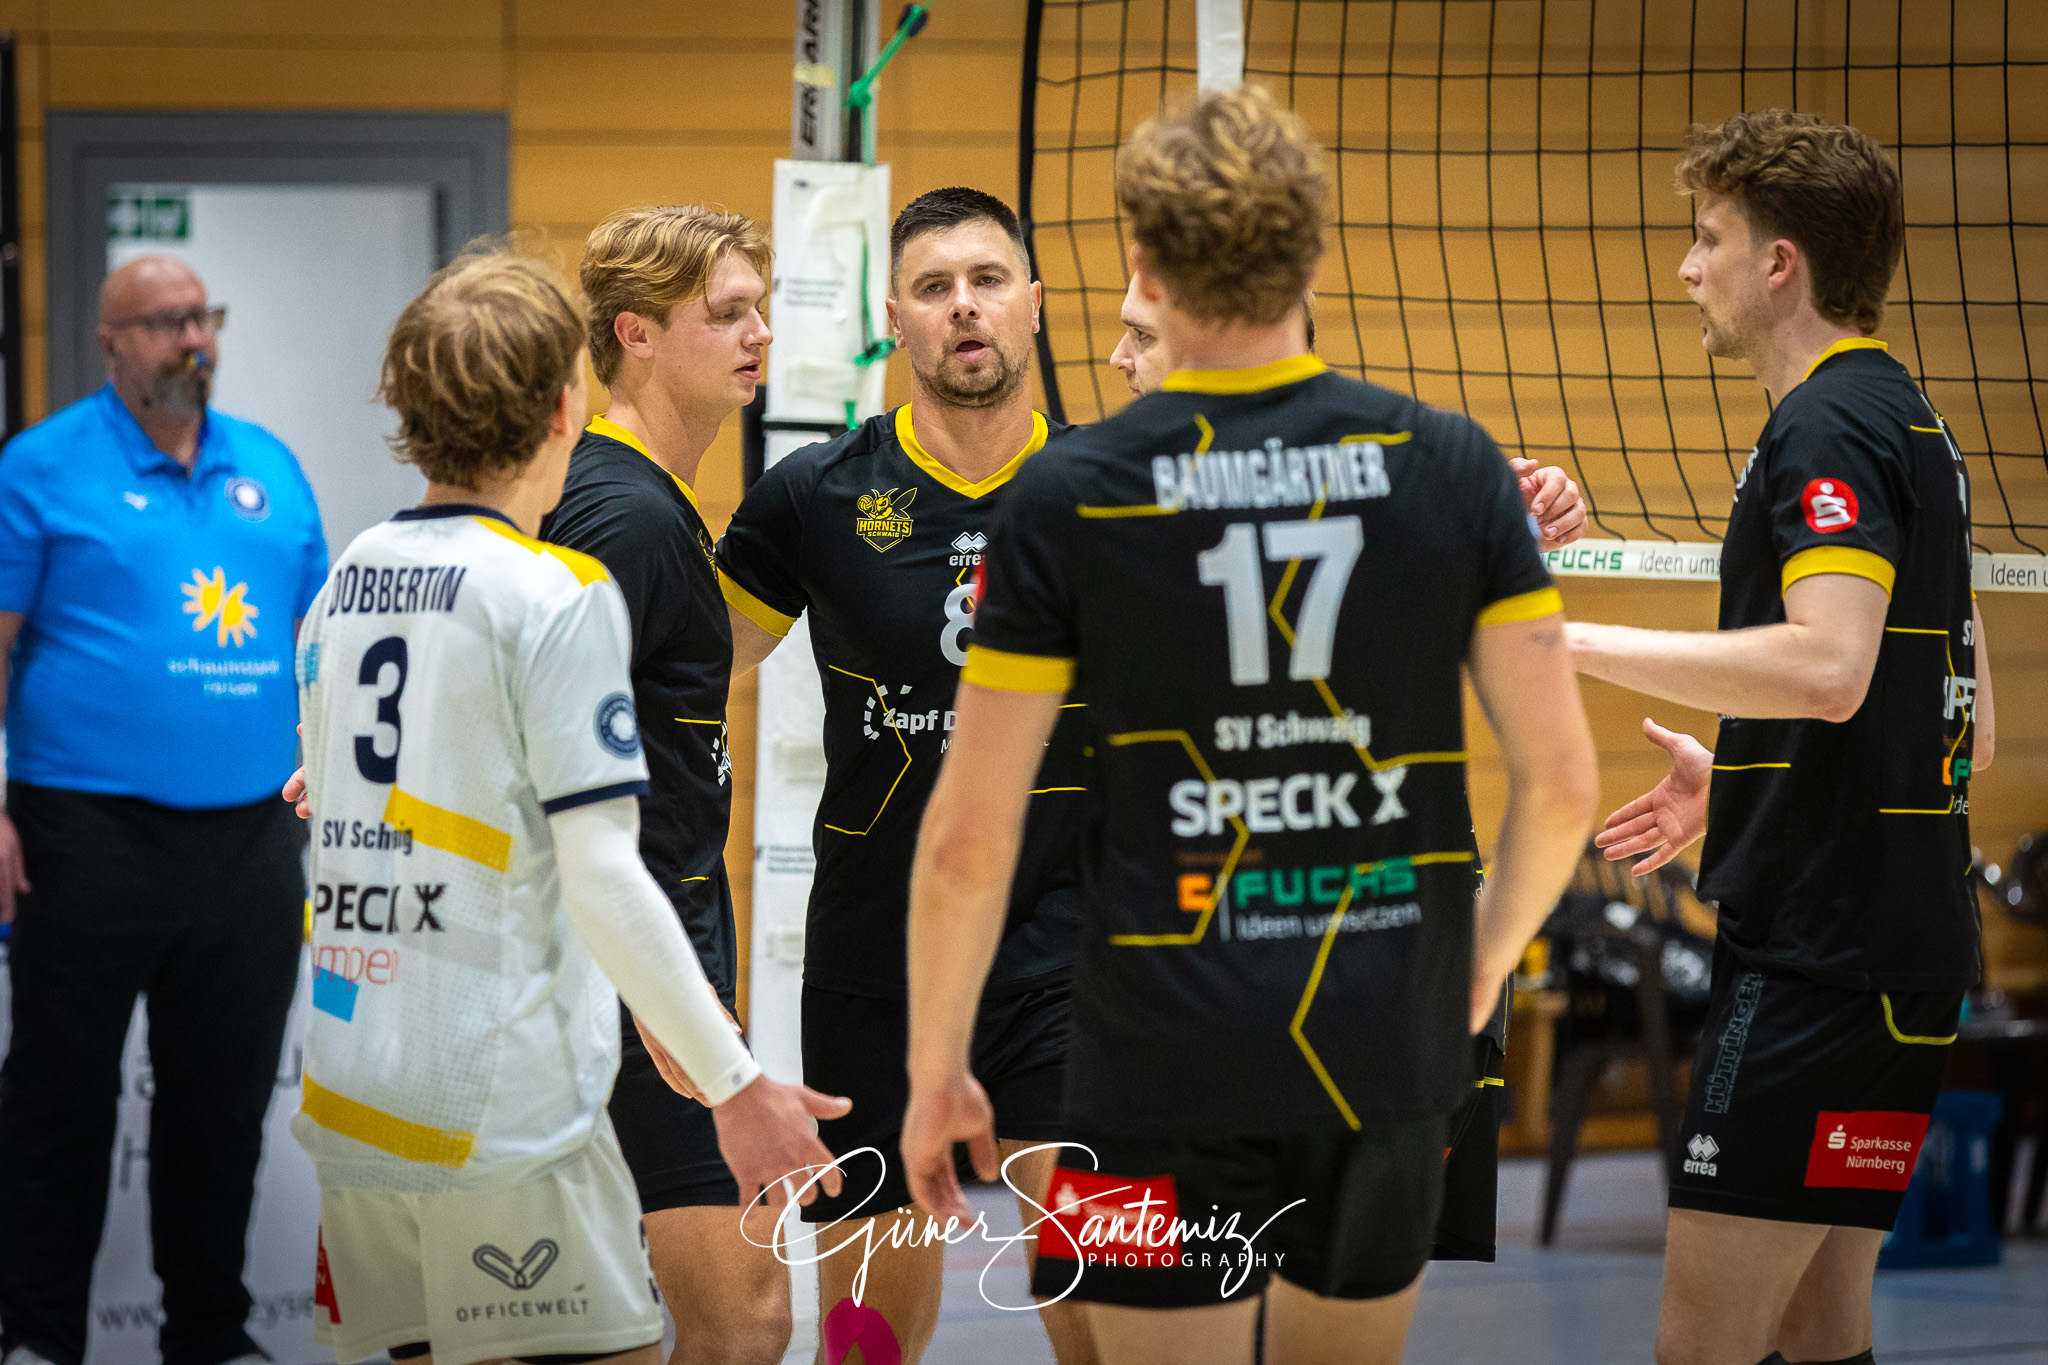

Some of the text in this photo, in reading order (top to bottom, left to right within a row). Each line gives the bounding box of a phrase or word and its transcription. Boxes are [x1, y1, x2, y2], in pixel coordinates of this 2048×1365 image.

[1152, 437, 1391, 510] BAUMGÄRTNER
[859, 520, 910, 534] HORNETS
[1547, 550, 1624, 571] FUCHS
[1639, 552, 1683, 574] Ideen
[1991, 562, 2037, 586] Ideen
[328, 565, 467, 618] DOBBERTIN
[1197, 514, 1364, 686] 17
[353, 635, 409, 784] 3
[883, 708, 939, 735] Zapf
[1169, 772, 1361, 837] SPECK
[322, 820, 346, 848] SV
[1234, 856, 1417, 908] FUCHS
[1849, 1136, 1912, 1152] Sparkasse
[1683, 1158, 1718, 1177] errea
[1846, 1155, 1906, 1174] Nürnberg
[455, 1299, 590, 1323] OFFICEWELT
